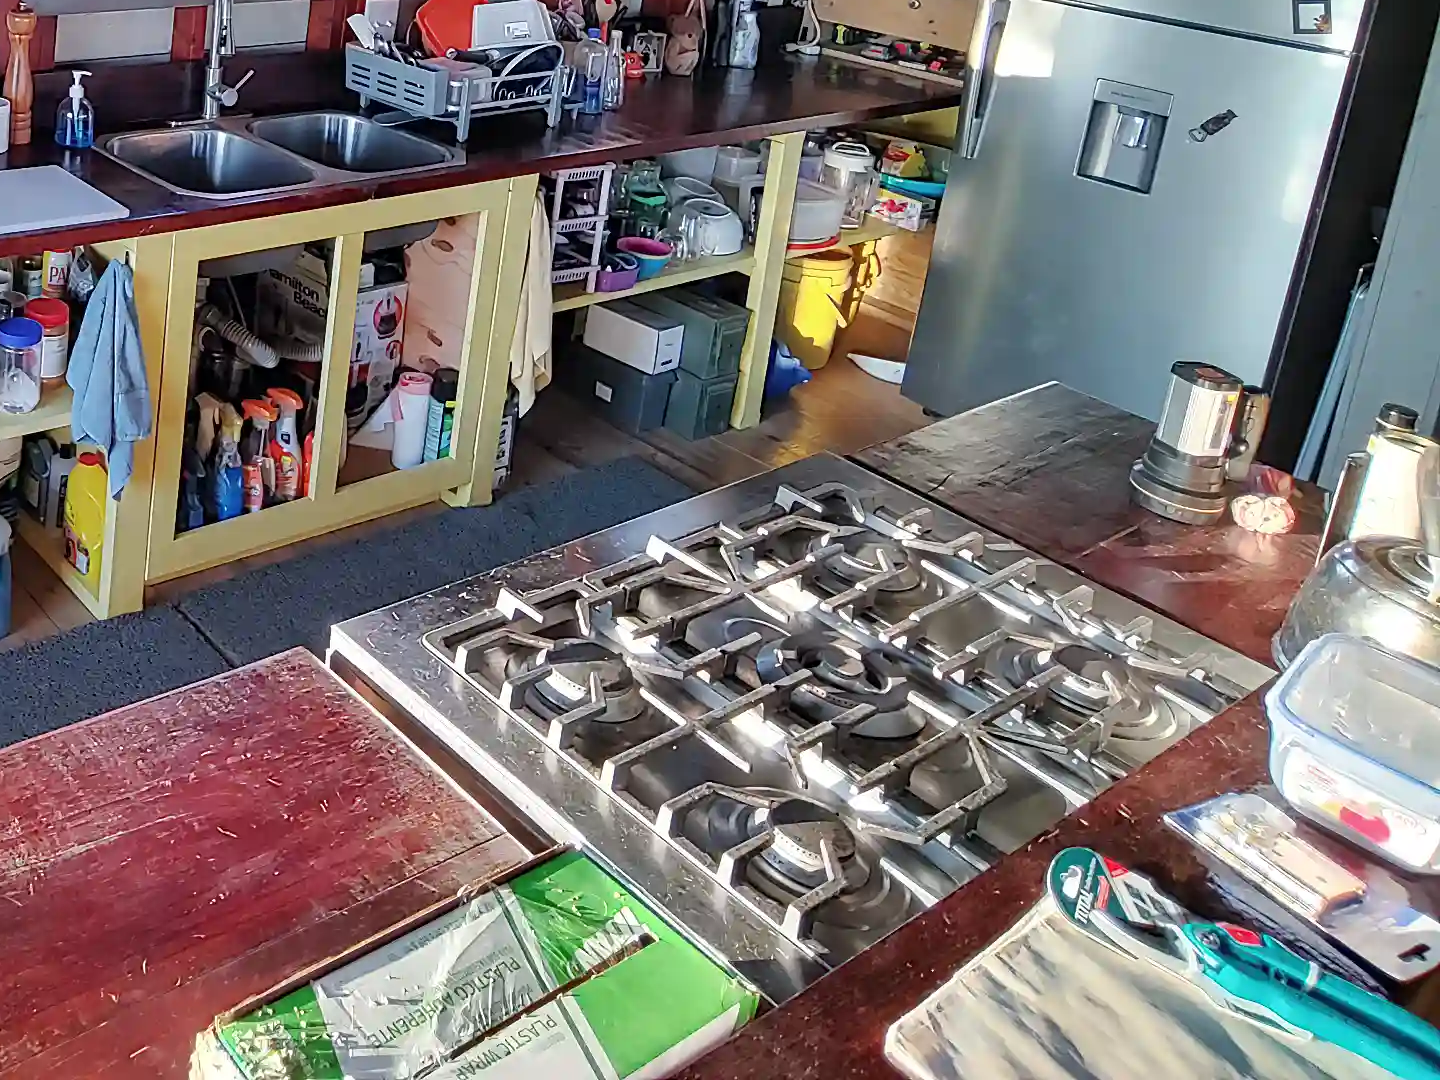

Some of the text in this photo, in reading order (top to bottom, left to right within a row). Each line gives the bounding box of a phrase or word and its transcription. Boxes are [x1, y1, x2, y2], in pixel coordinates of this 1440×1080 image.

[49, 266, 69, 284] PA
[293, 291, 326, 318] Beac
[500, 1013, 558, 1057] PLASTIC
[456, 1042, 503, 1080] WRAP
